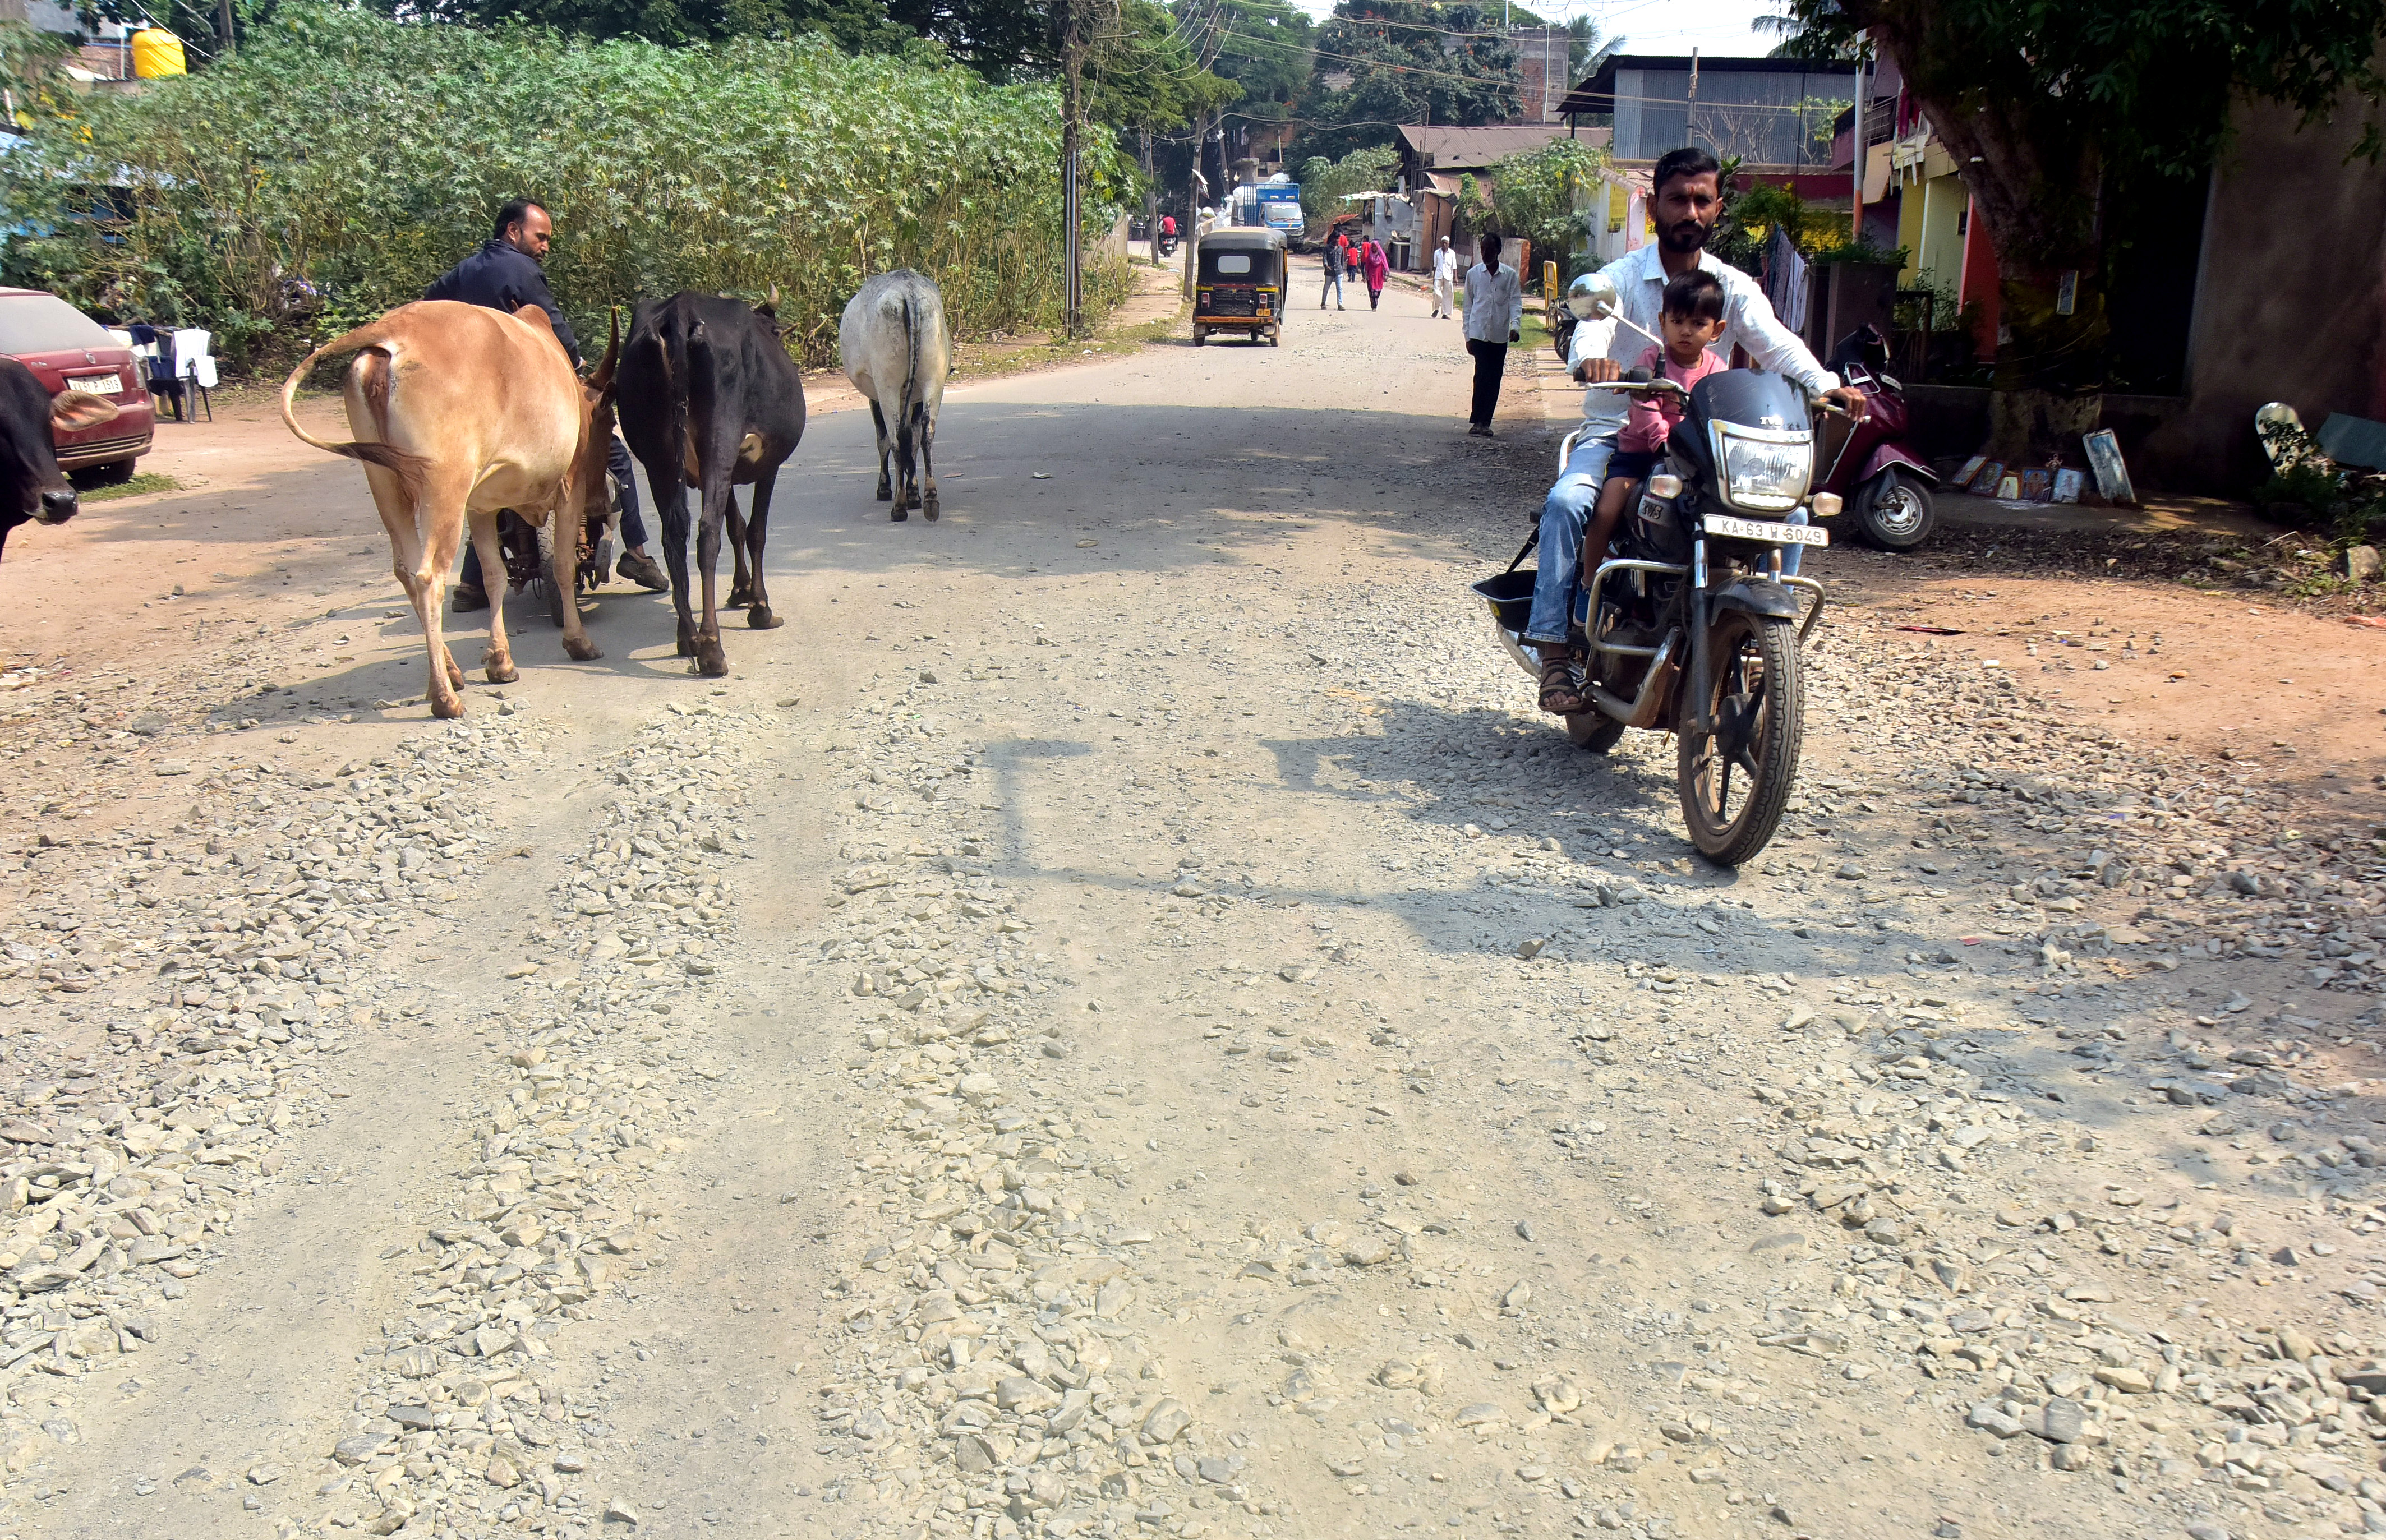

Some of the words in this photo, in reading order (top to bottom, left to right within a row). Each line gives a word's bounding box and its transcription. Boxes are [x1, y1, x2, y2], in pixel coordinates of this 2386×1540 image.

[1722, 520, 1739, 534] KA
[1746, 523, 1763, 537] 63
[1785, 528, 1821, 543] 6049
